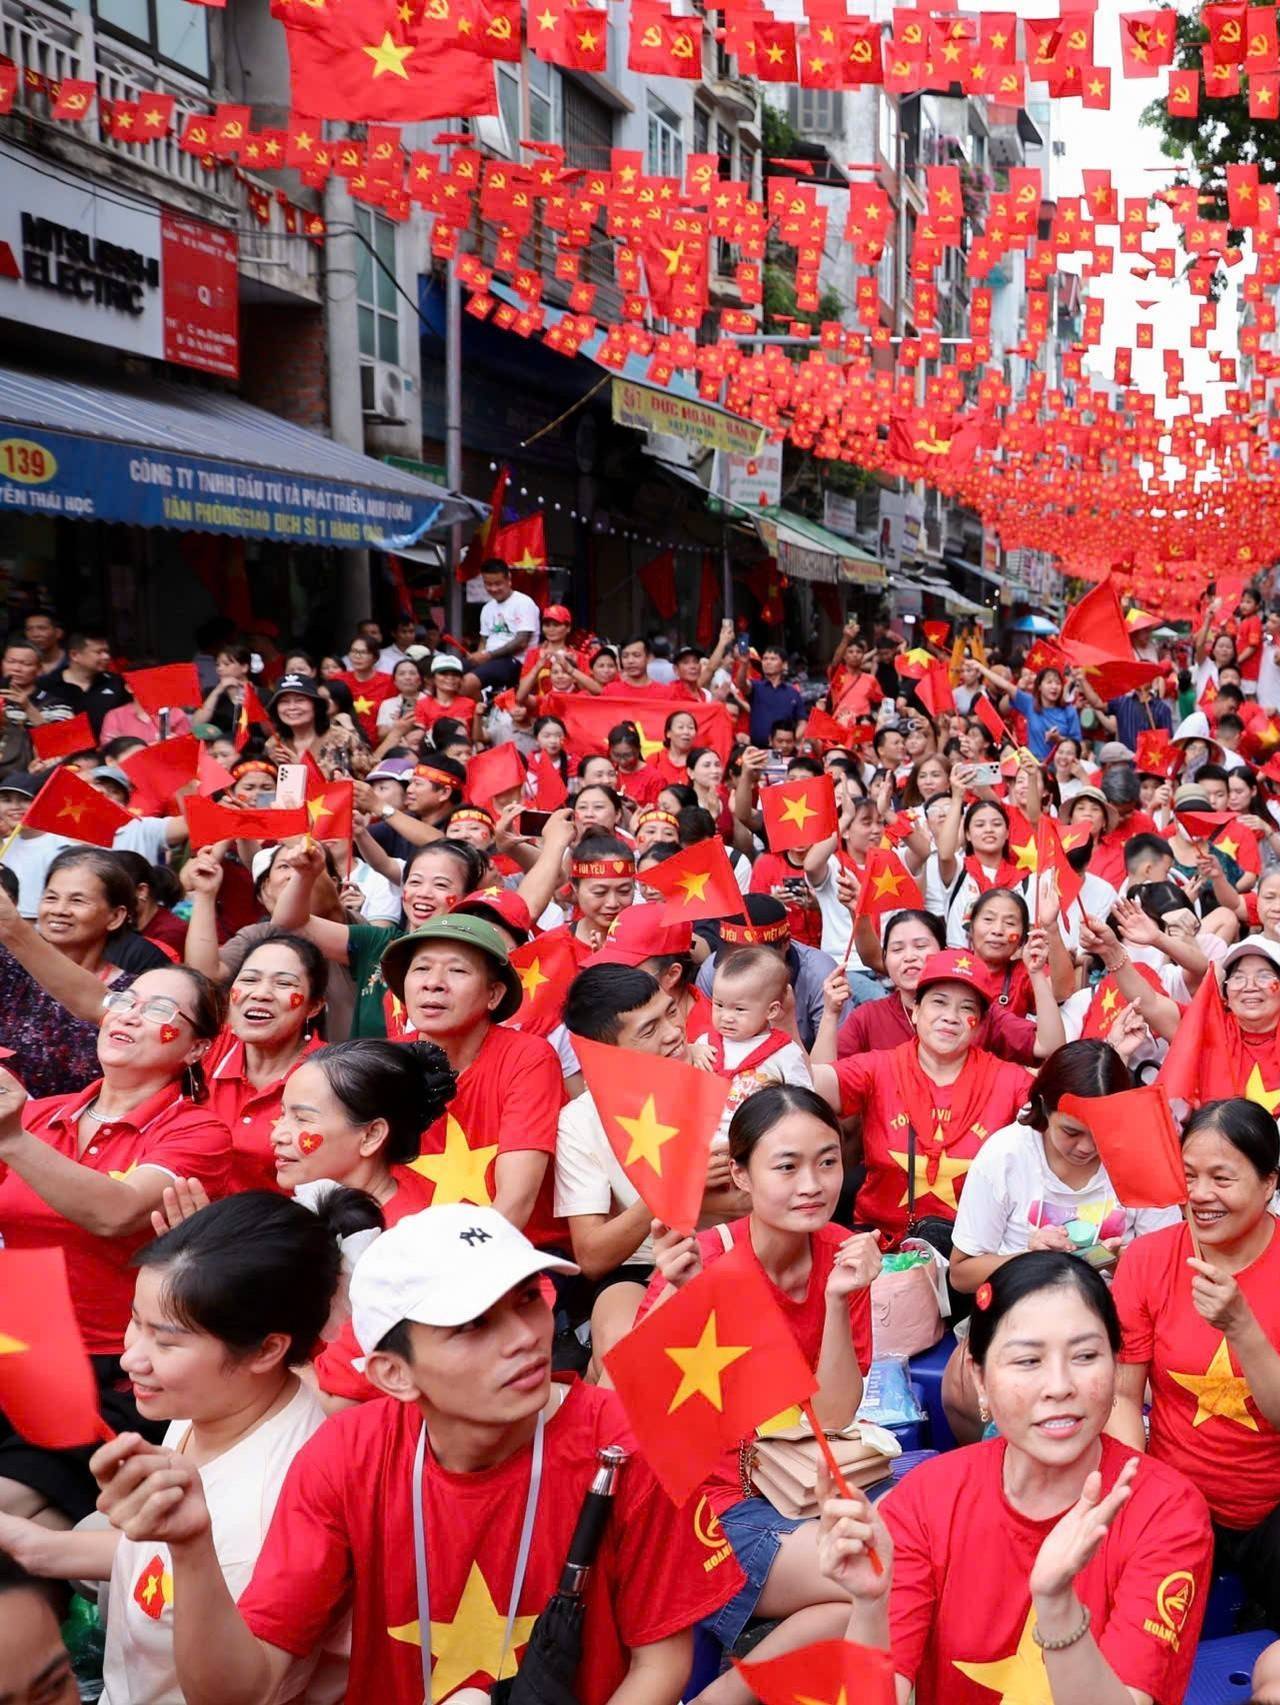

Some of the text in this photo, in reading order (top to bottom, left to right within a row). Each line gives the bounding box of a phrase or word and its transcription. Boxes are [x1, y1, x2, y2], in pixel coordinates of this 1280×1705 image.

[20, 211, 159, 288] MITSUBISHI
[23, 250, 145, 315] ELECTRIC
[4, 445, 45, 478] 139
[129, 457, 173, 488] CÔNG
[175, 466, 194, 490] TY
